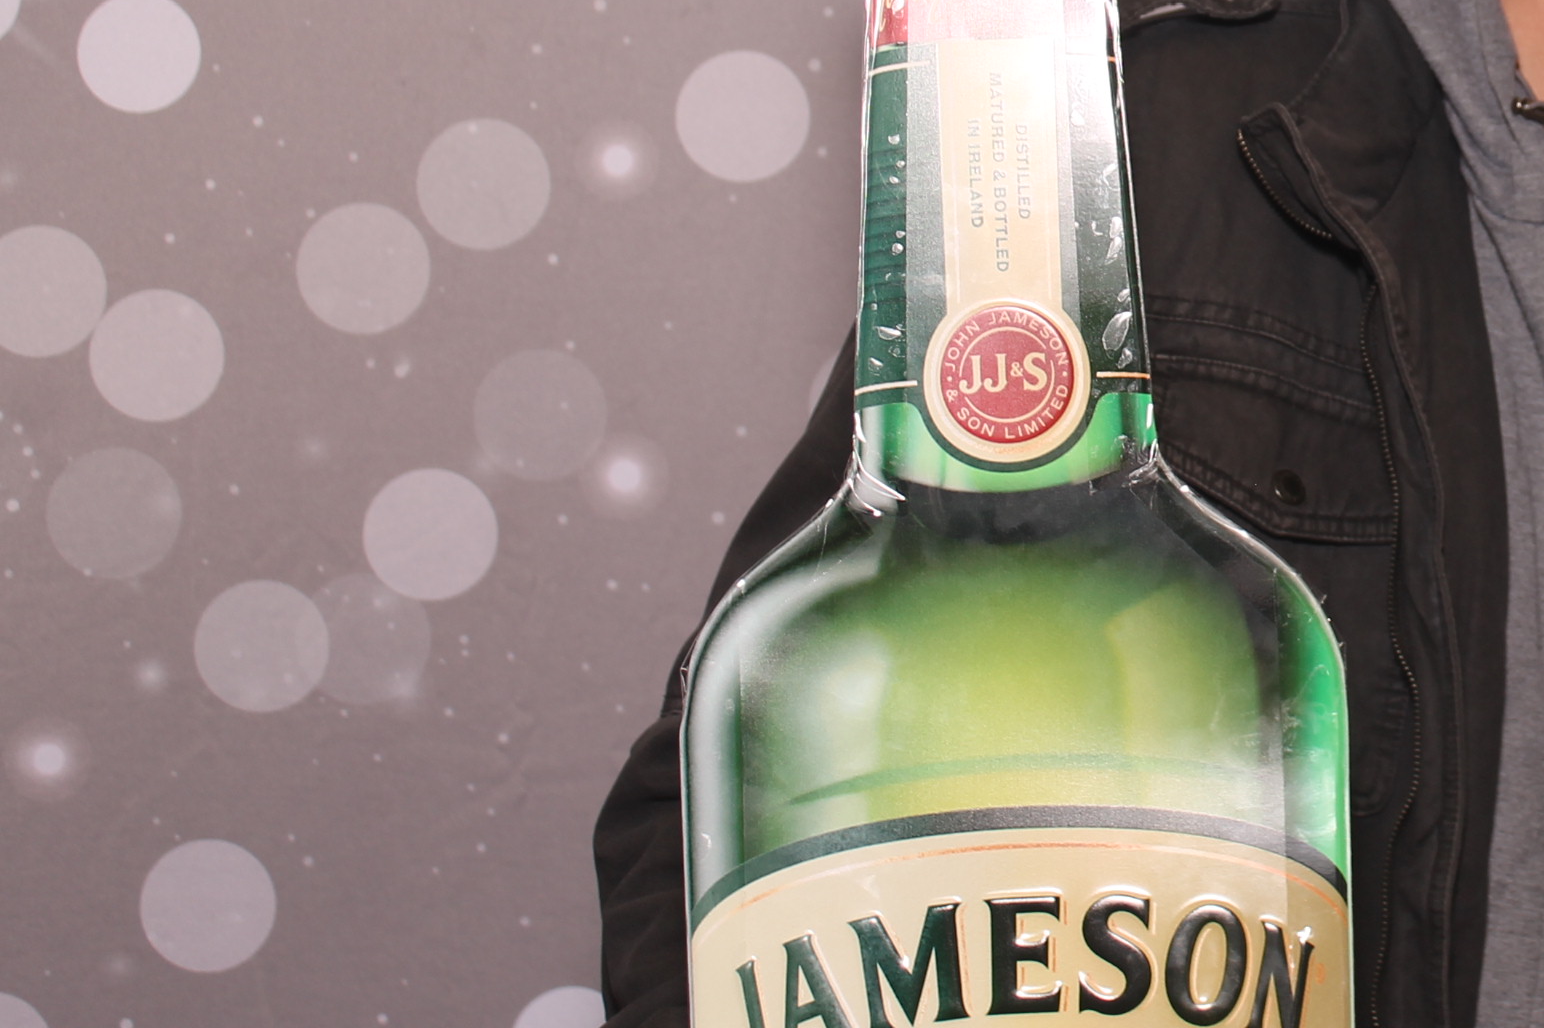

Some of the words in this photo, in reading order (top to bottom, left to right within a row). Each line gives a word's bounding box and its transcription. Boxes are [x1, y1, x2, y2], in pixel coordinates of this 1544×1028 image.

[968, 119, 980, 138] IN
[989, 72, 1004, 163] MATURED
[969, 145, 984, 229] IRELAND
[993, 171, 1006, 182] &
[1015, 124, 1030, 220] DISTILLED
[994, 187, 1009, 272] BOTTLED
[944, 320, 981, 372] JOHN
[988, 310, 1070, 366] JAMESON
[956, 406, 996, 437] SON
[1004, 384, 1069, 440] LIMITED
